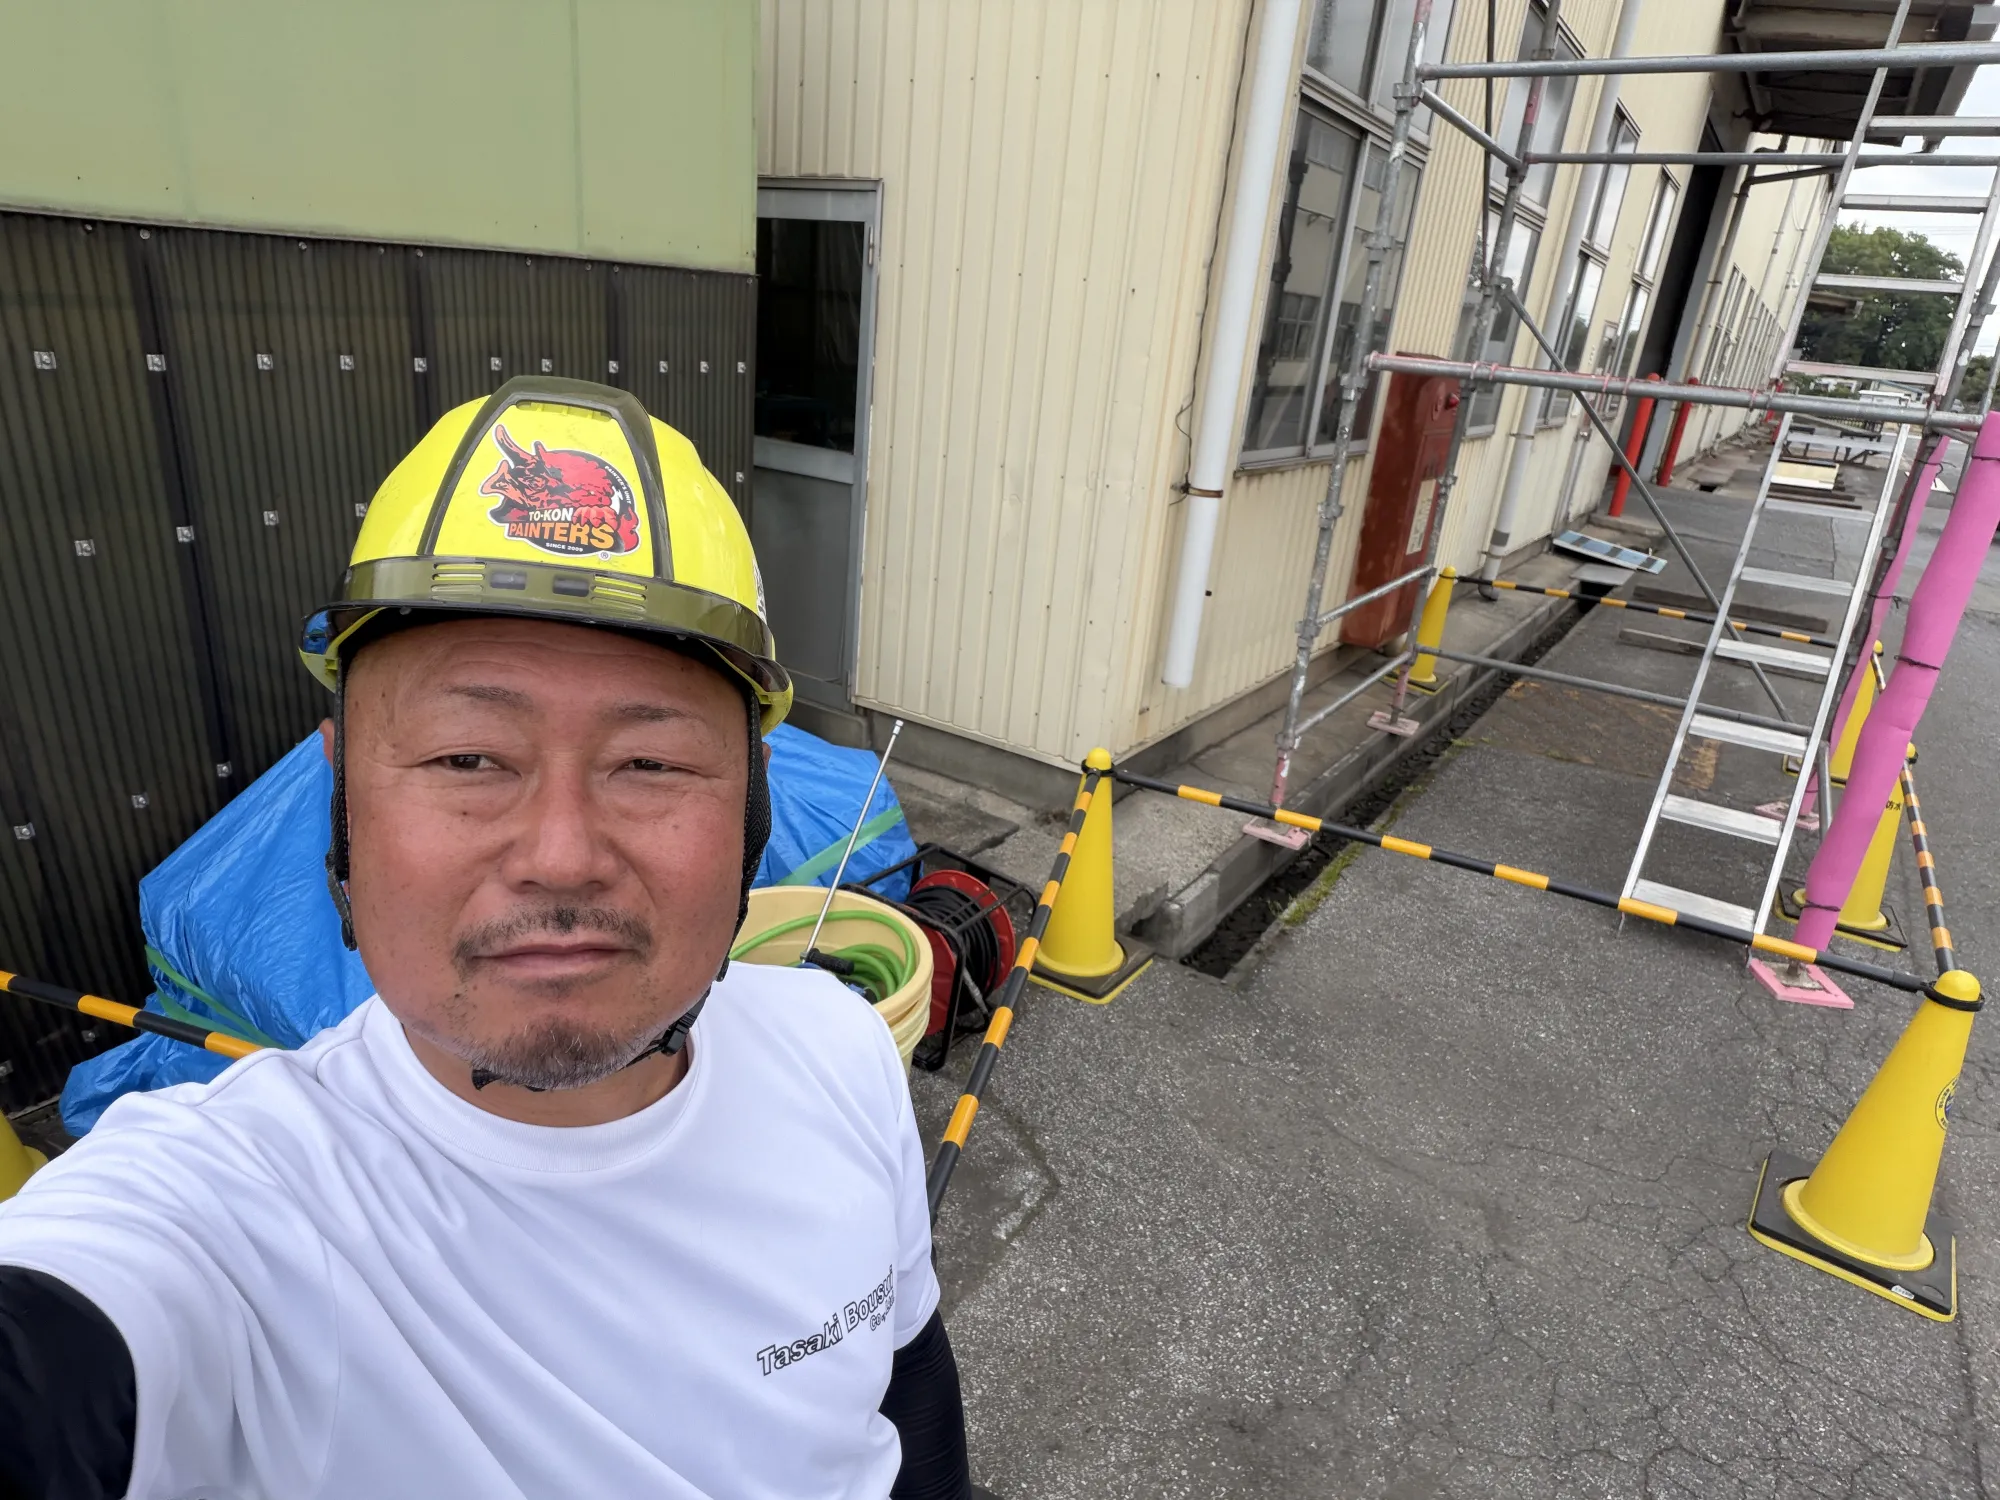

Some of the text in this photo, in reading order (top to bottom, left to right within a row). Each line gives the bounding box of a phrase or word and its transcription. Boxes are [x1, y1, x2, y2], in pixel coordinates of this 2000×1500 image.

[605, 466, 632, 504] PAINTER'S UNIT
[529, 508, 574, 522] TO-KON
[509, 522, 614, 549] PAINTERS
[546, 542, 566, 550] SINCE
[756, 1264, 894, 1376] Tasaki Bousui
